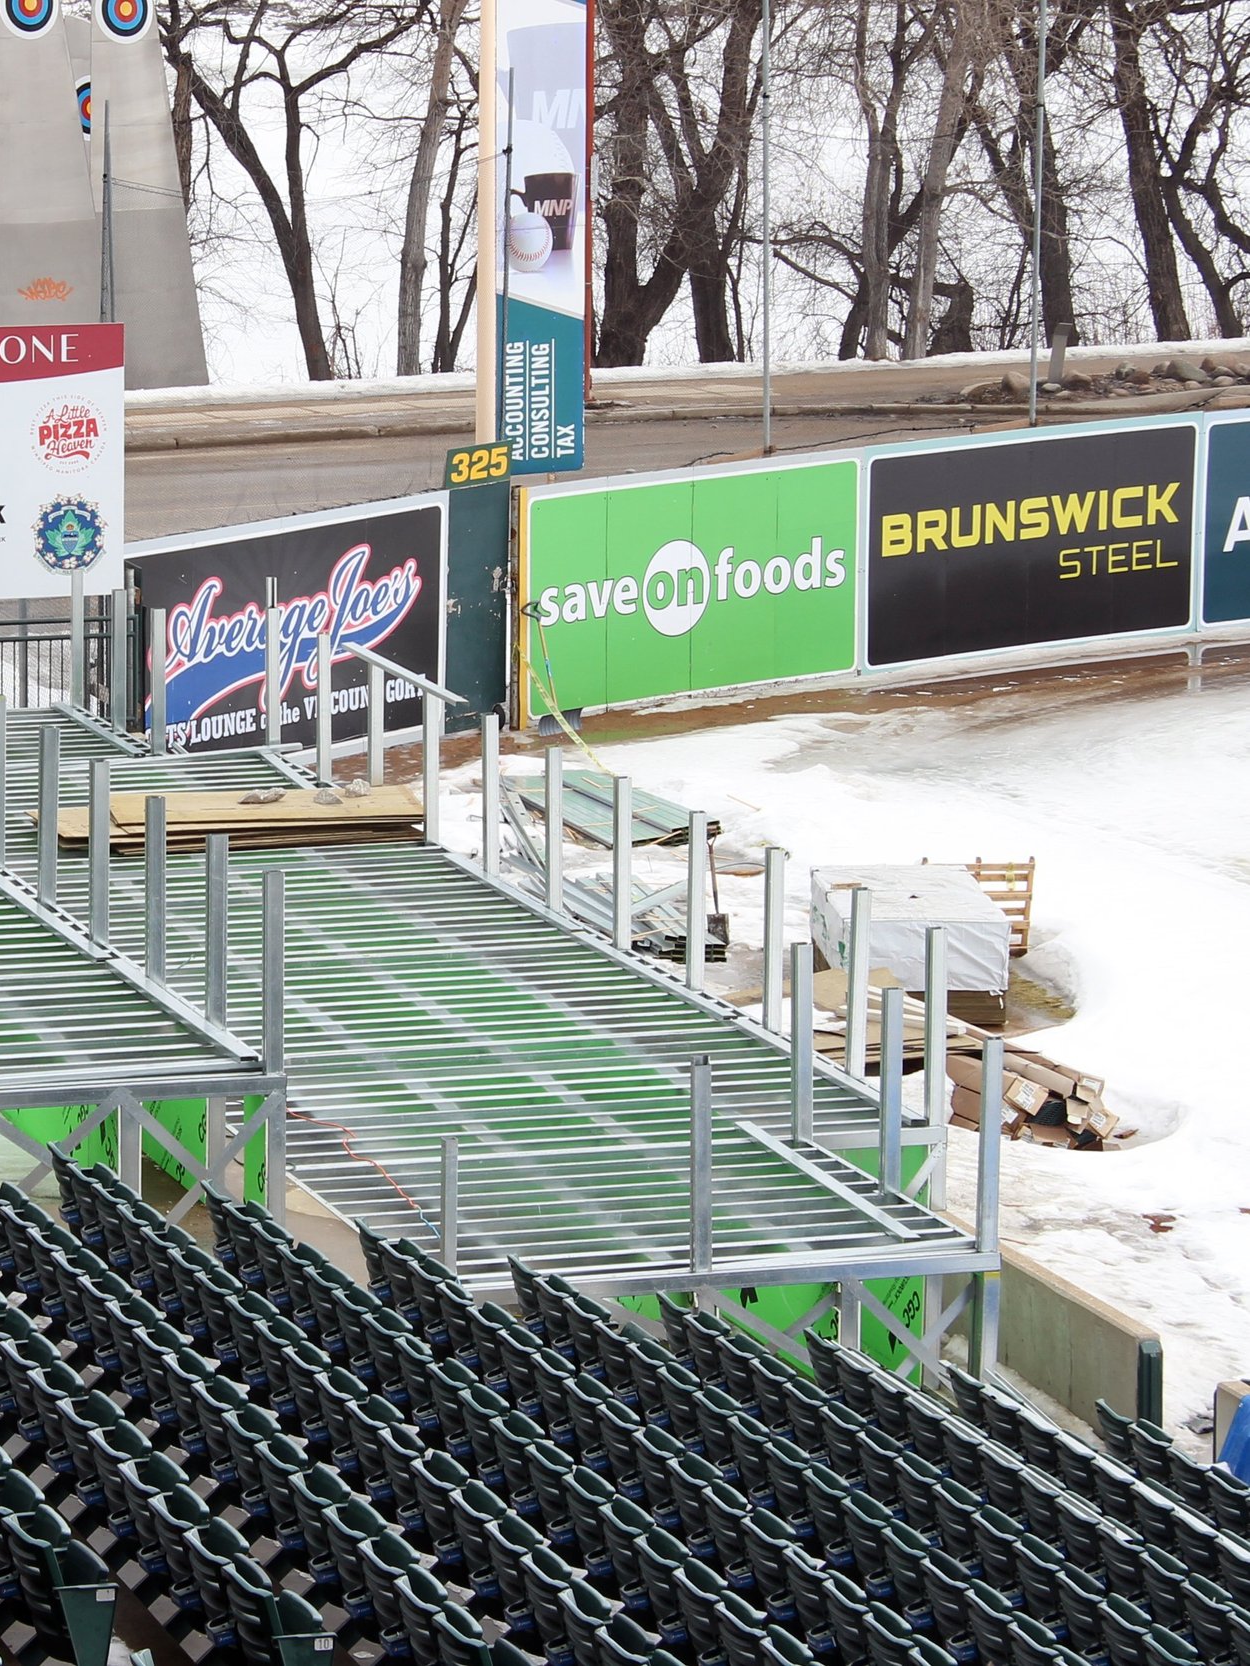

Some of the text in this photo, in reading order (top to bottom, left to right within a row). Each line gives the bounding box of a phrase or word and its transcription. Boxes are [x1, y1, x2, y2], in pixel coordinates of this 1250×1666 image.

[532, 88, 586, 129] MN
[533, 198, 573, 217] MNP
[54, 404, 91, 424] Little
[505, 341, 525, 461] ACCOUNTING
[531, 343, 550, 459] CONSULTING
[38, 418, 99, 446] PIZZA
[46, 438, 96, 455] Heaven
[556, 423, 575, 458] TAX
[451, 446, 509, 483] 325
[881, 482, 1180, 557] BRUNSWICK
[1058, 539, 1179, 580] STEEL
[538, 536, 847, 628] save on foods
[306, 545, 422, 686] Joe's
[190, 708, 256, 744] LOUNGE
[317, 1639, 330, 1650] 10
